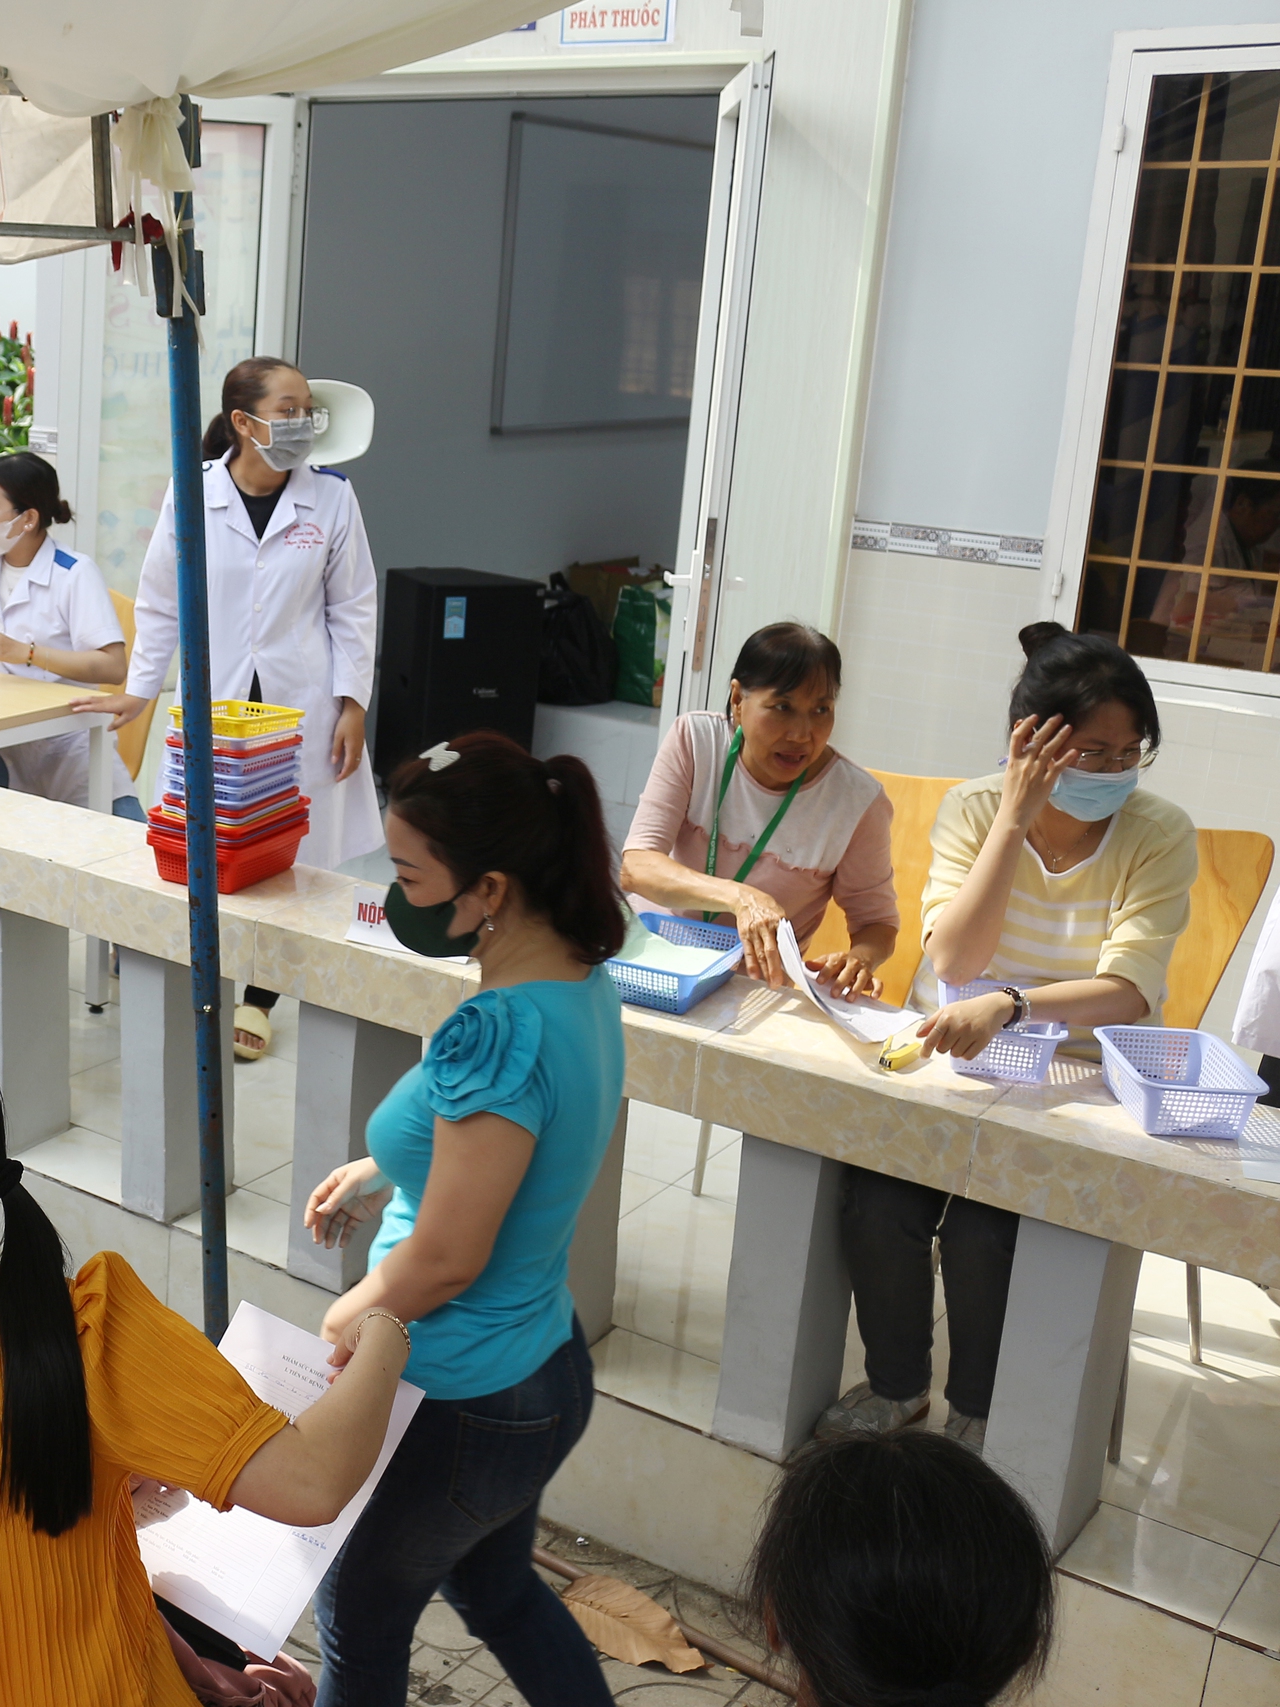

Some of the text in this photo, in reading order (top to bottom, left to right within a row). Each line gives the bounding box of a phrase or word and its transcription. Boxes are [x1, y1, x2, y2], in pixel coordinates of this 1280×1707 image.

[570, 0, 660, 29] PHÁT THUỐC
[357, 901, 387, 928] NỘP
